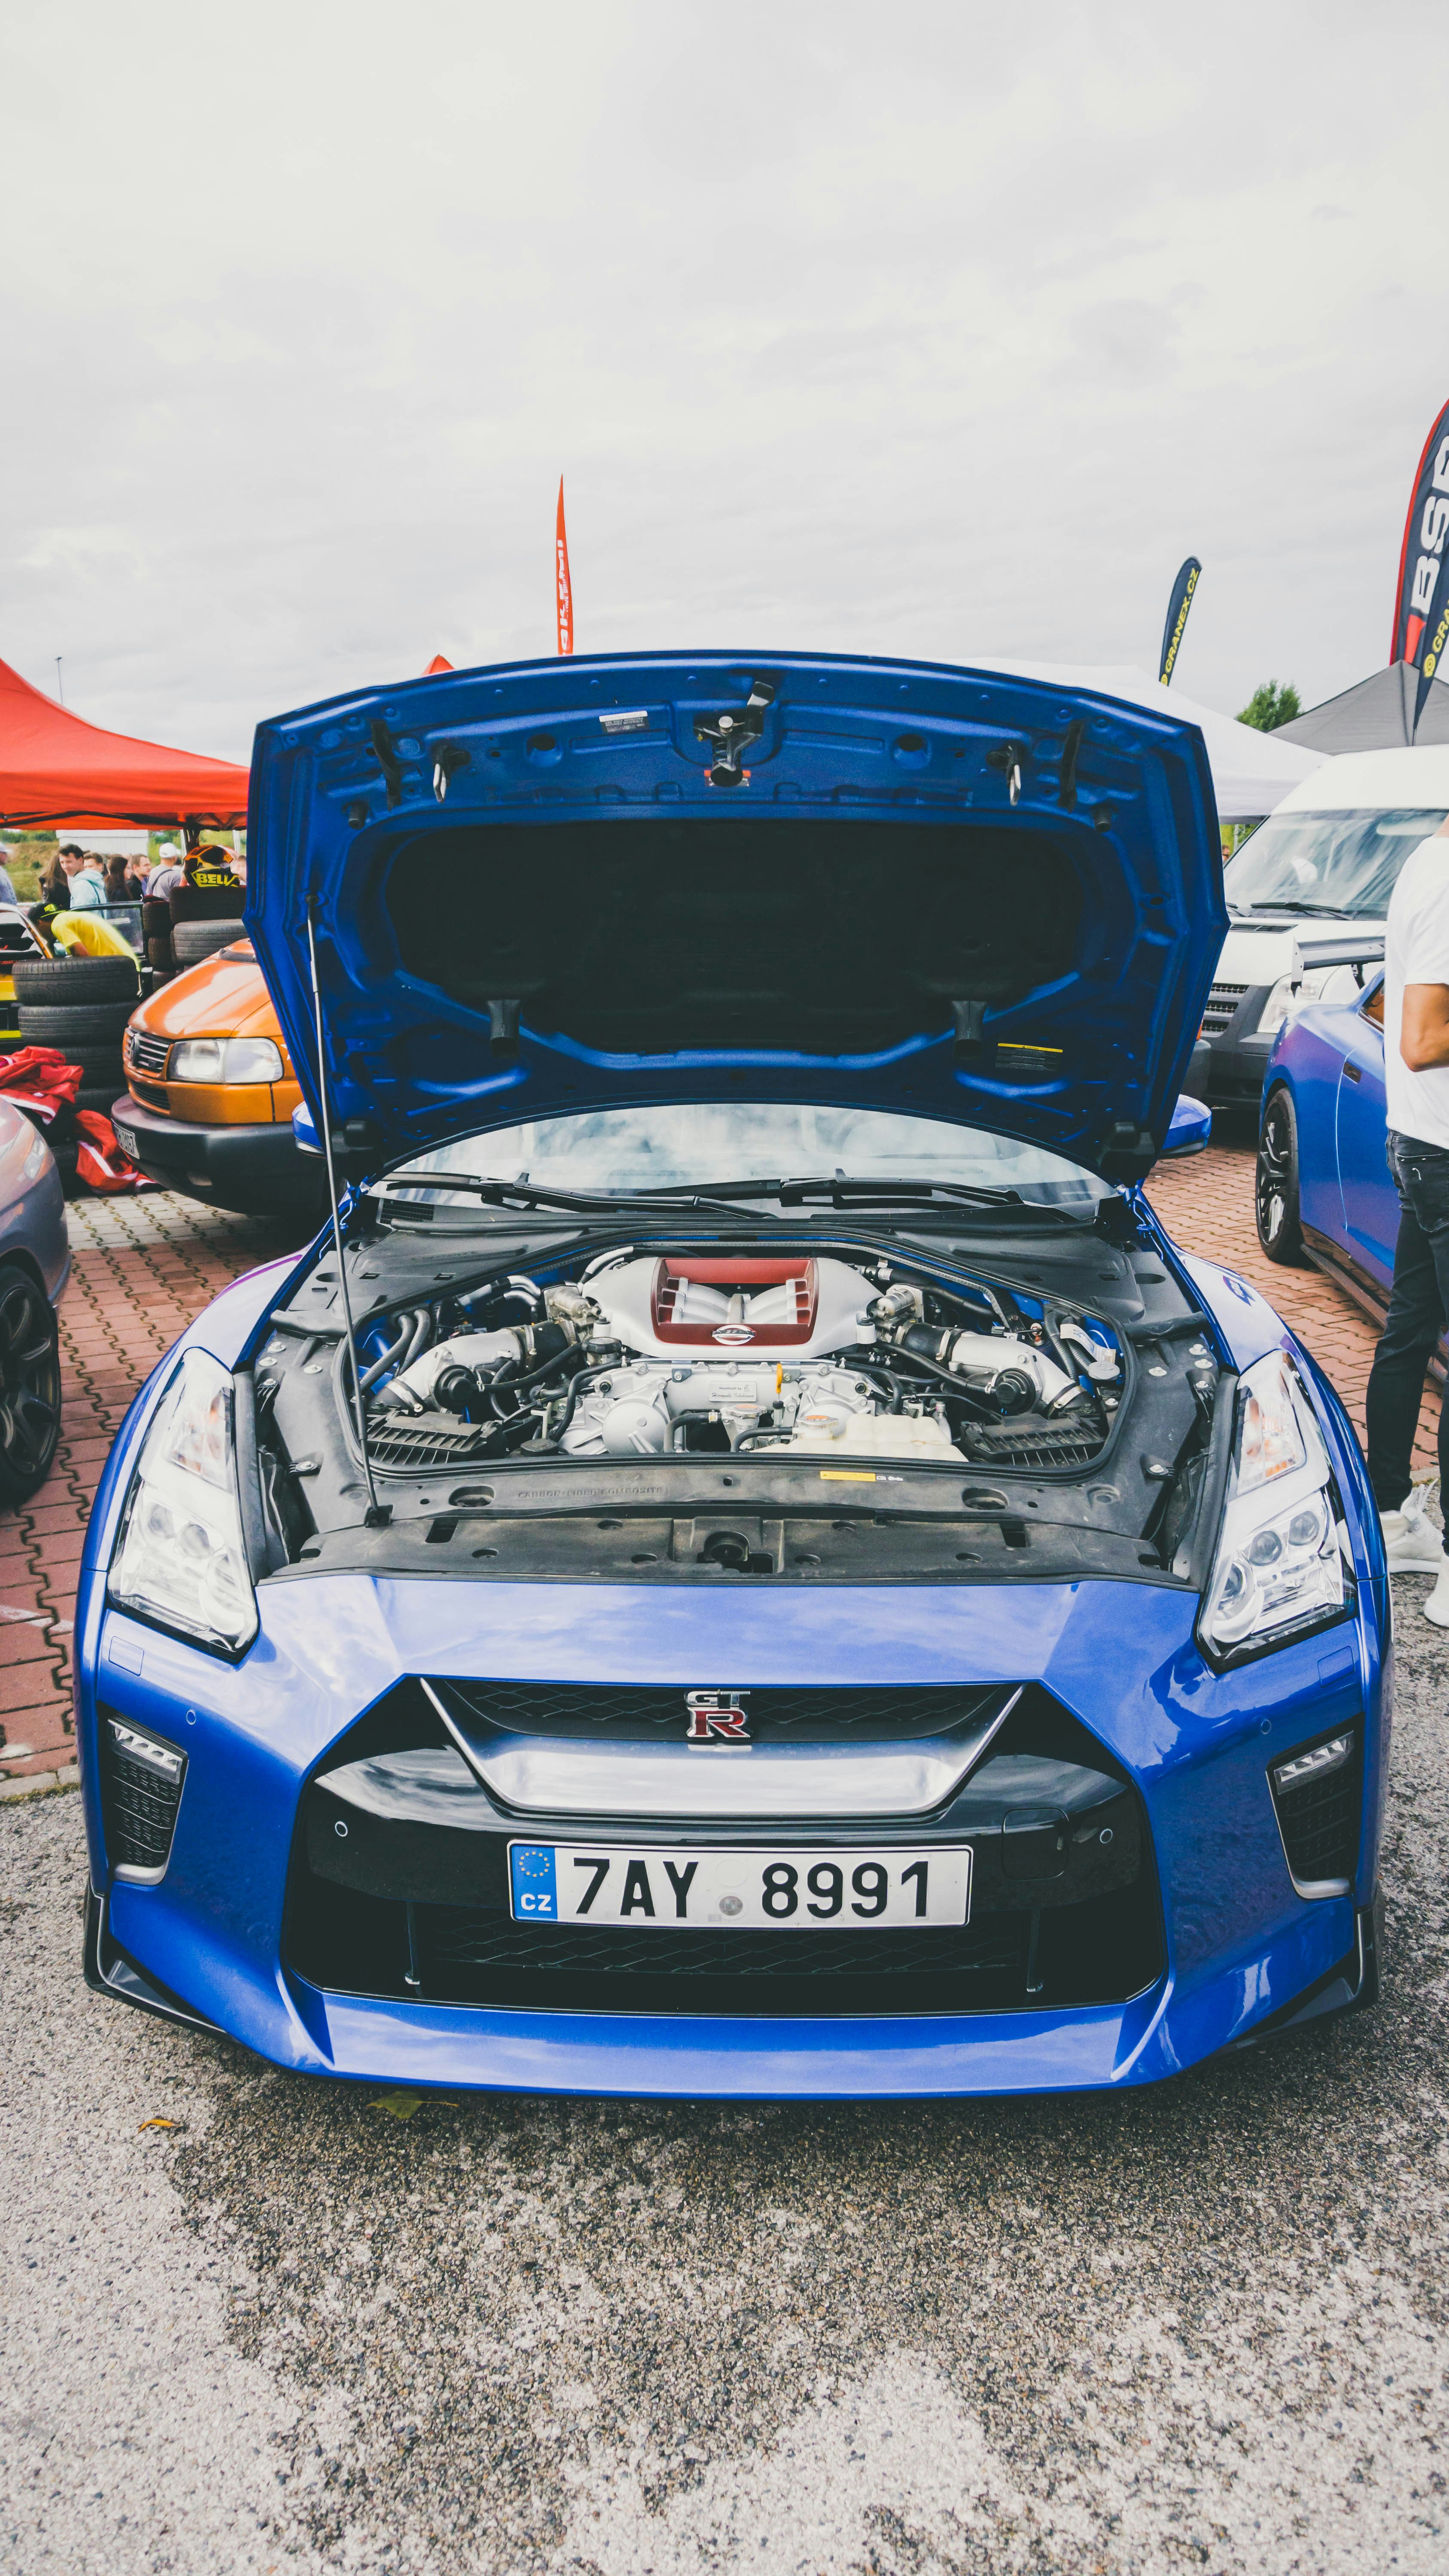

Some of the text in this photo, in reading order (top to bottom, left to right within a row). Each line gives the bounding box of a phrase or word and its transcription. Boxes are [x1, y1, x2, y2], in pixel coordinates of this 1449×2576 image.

[1164, 568, 1199, 674] GRANEX.CZ
[521, 1894, 552, 1911] CZ
[573, 1857, 929, 1919] 7AY 8991
